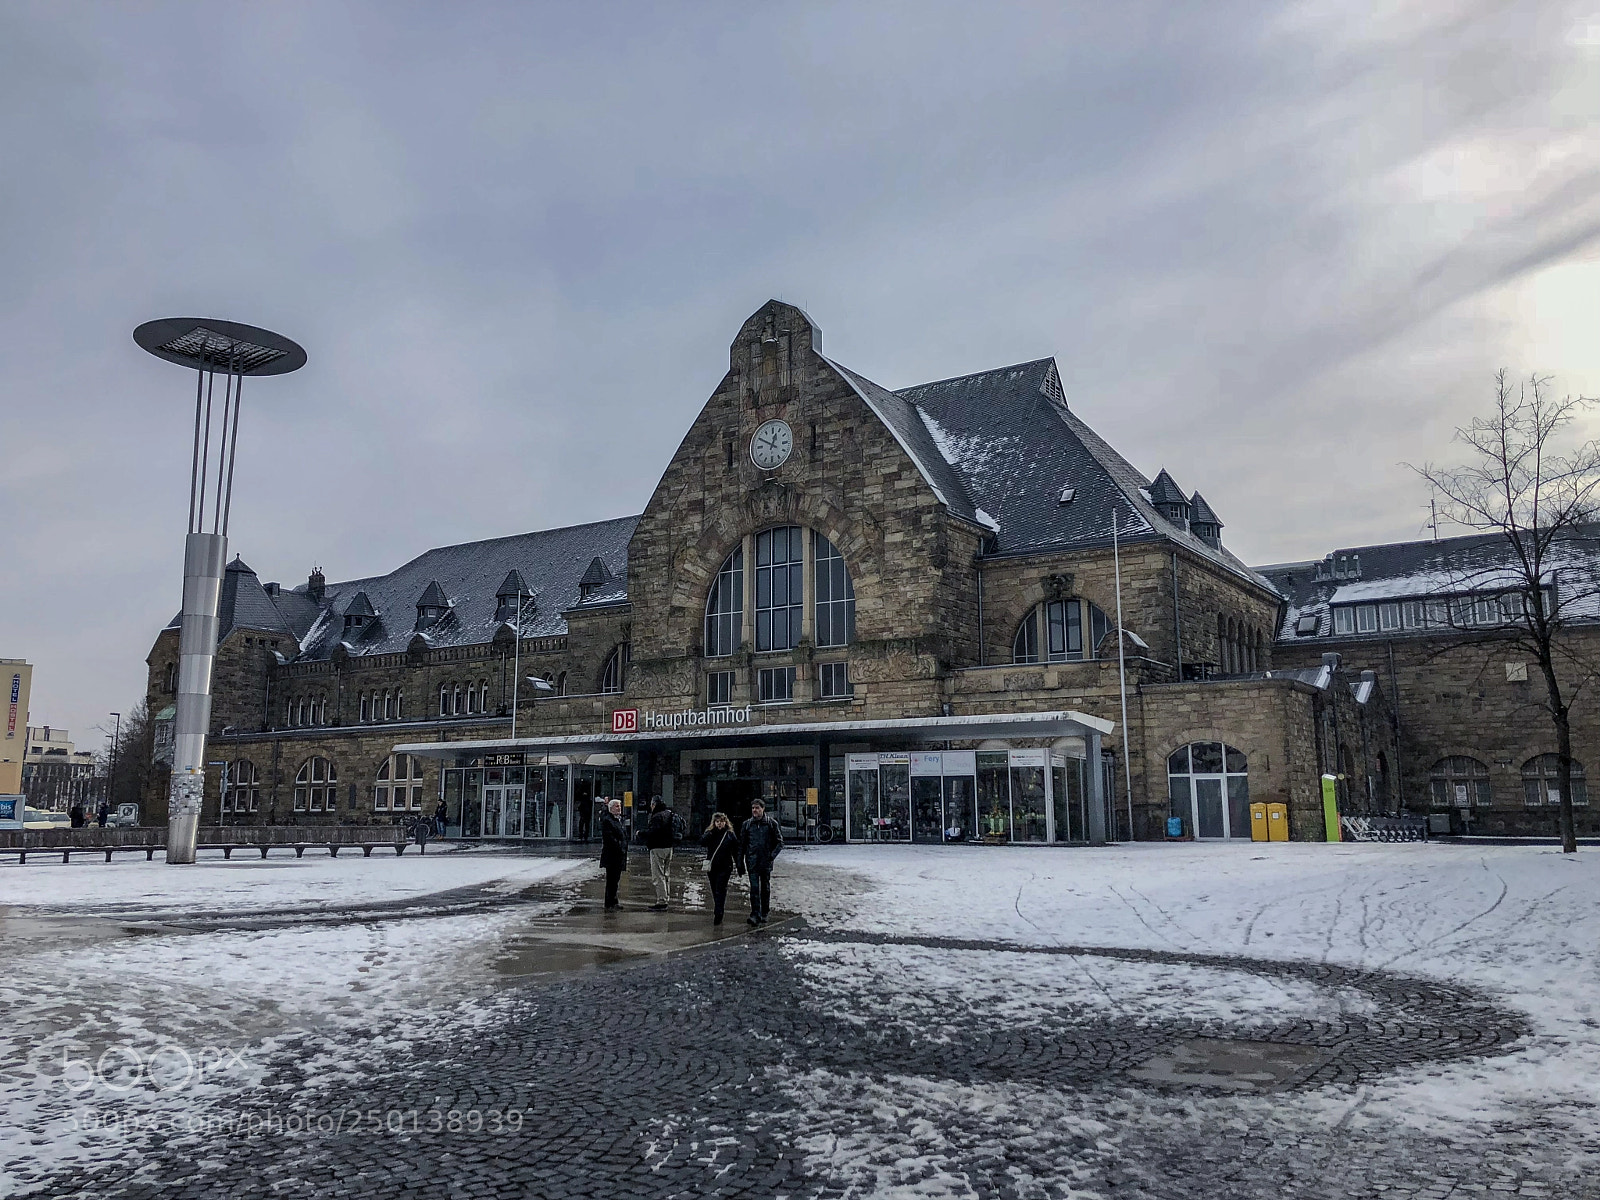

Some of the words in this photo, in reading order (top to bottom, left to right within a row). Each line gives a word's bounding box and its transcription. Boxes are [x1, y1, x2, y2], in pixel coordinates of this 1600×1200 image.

[12, 679, 20, 702] HOTEL
[615, 712, 635, 730] DB
[645, 704, 752, 730] Hauptbahnhof
